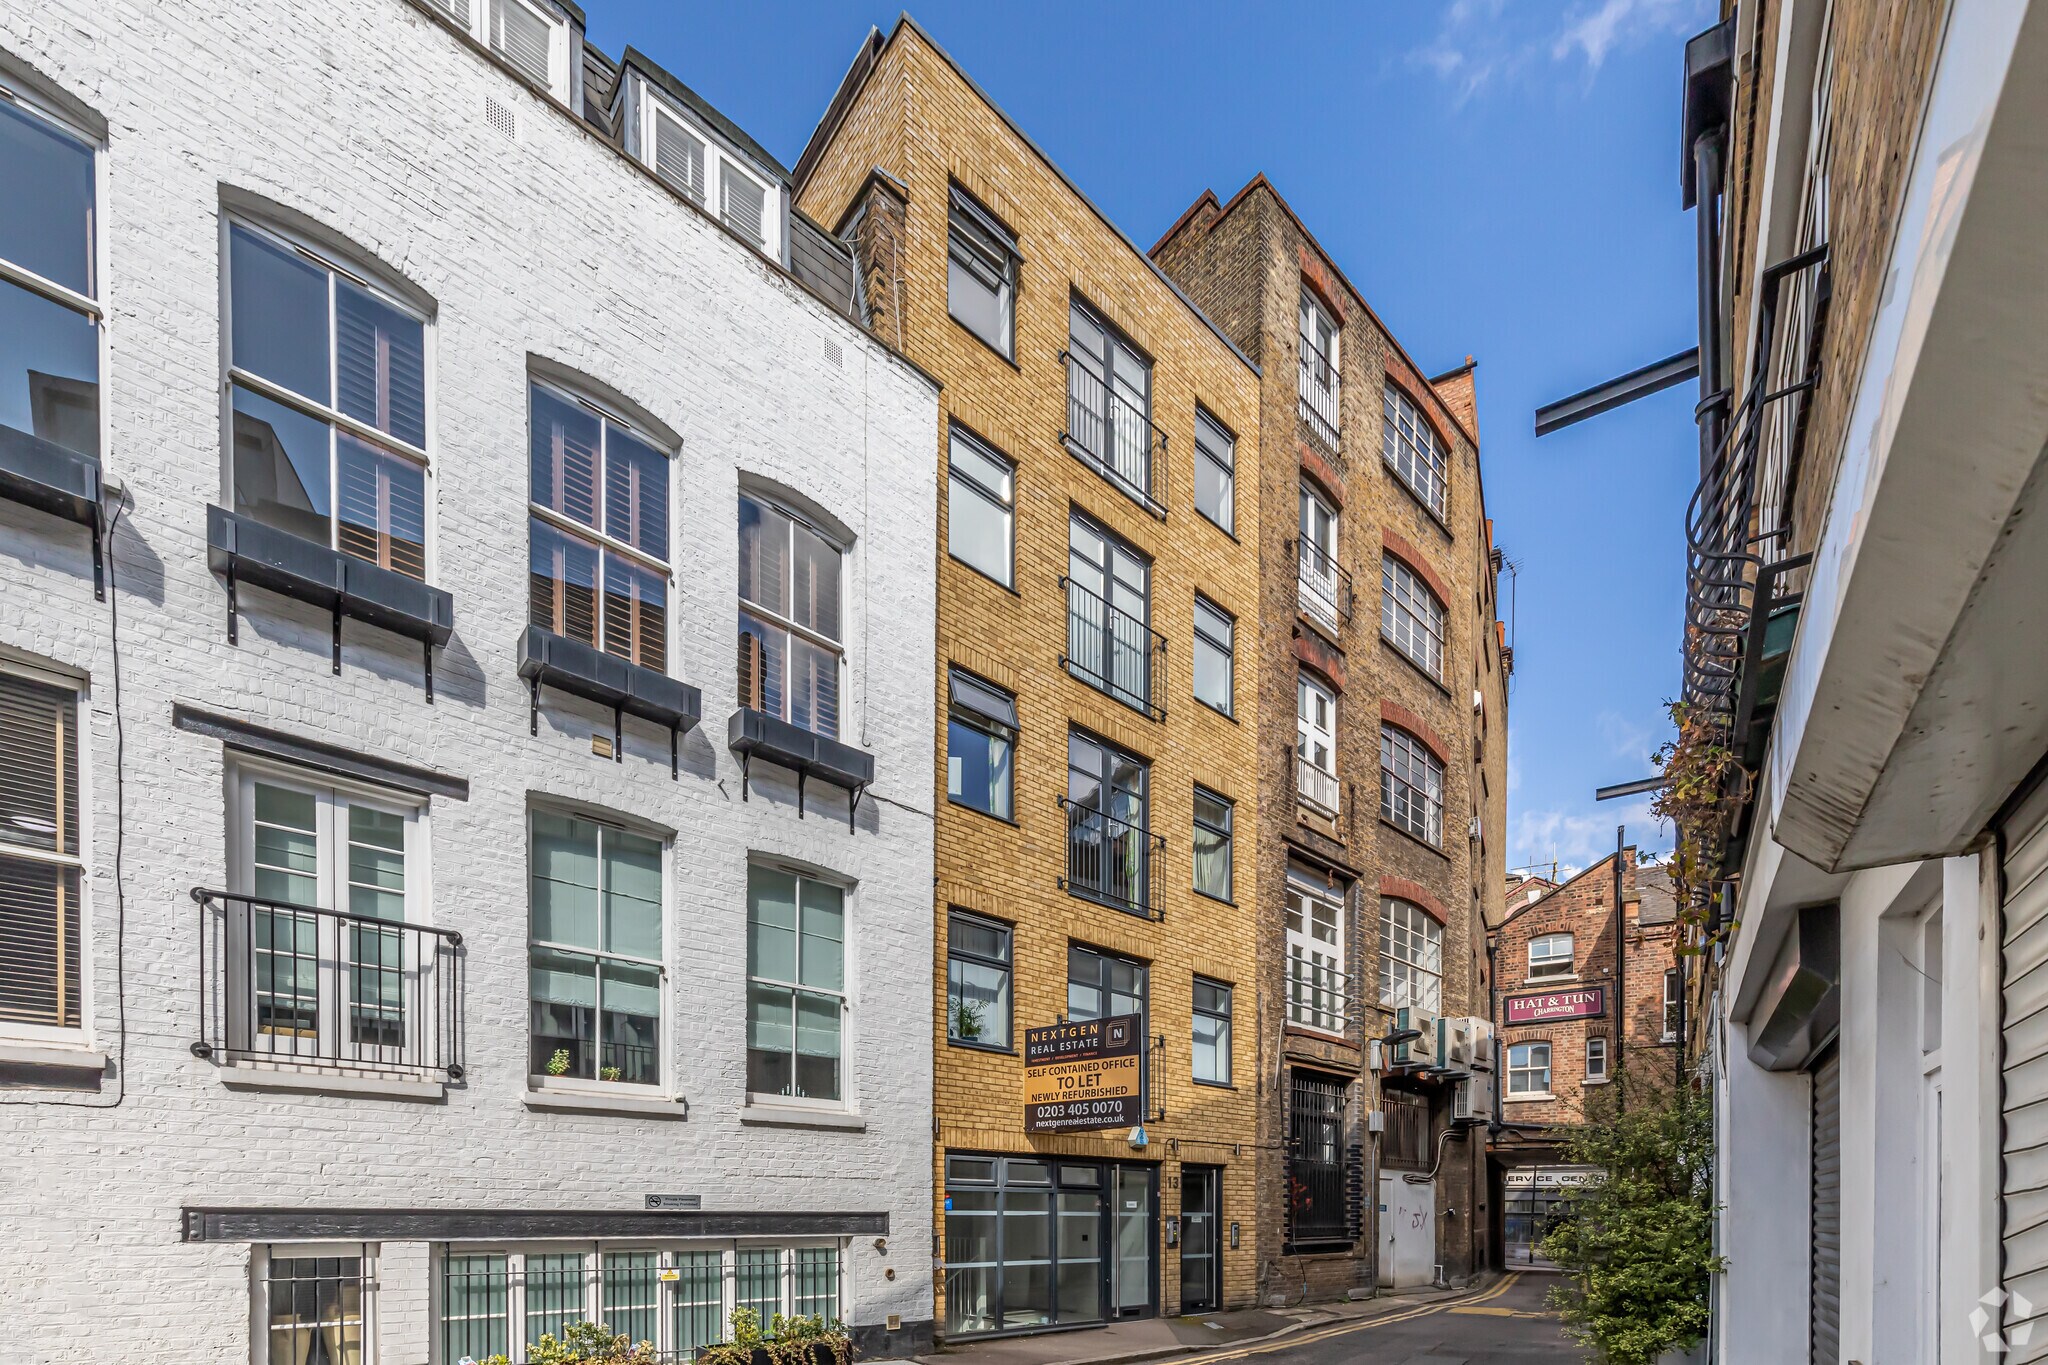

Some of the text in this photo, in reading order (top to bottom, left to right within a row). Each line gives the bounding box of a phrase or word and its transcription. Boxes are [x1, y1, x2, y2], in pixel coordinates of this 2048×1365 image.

[1514, 992, 1596, 1010] HAT & TUN
[1533, 1005, 1575, 1017] CHARRINGTON
[1031, 1023, 1099, 1043] NEXTGEN
[1113, 1028, 1123, 1039] N
[1030, 1038, 1099, 1055] REAL ESTATE
[1027, 1058, 1135, 1079] SELF CONTAINED OFFICE
[1057, 1073, 1102, 1090] TO LET
[1031, 1085, 1128, 1103] NEWLY REFURBISHIED
[1037, 1100, 1123, 1118] 0203 405 0070
[1035, 1113, 1125, 1129] nextgenrealestate.co.uk
[1167, 1176, 1179, 1189] 13
